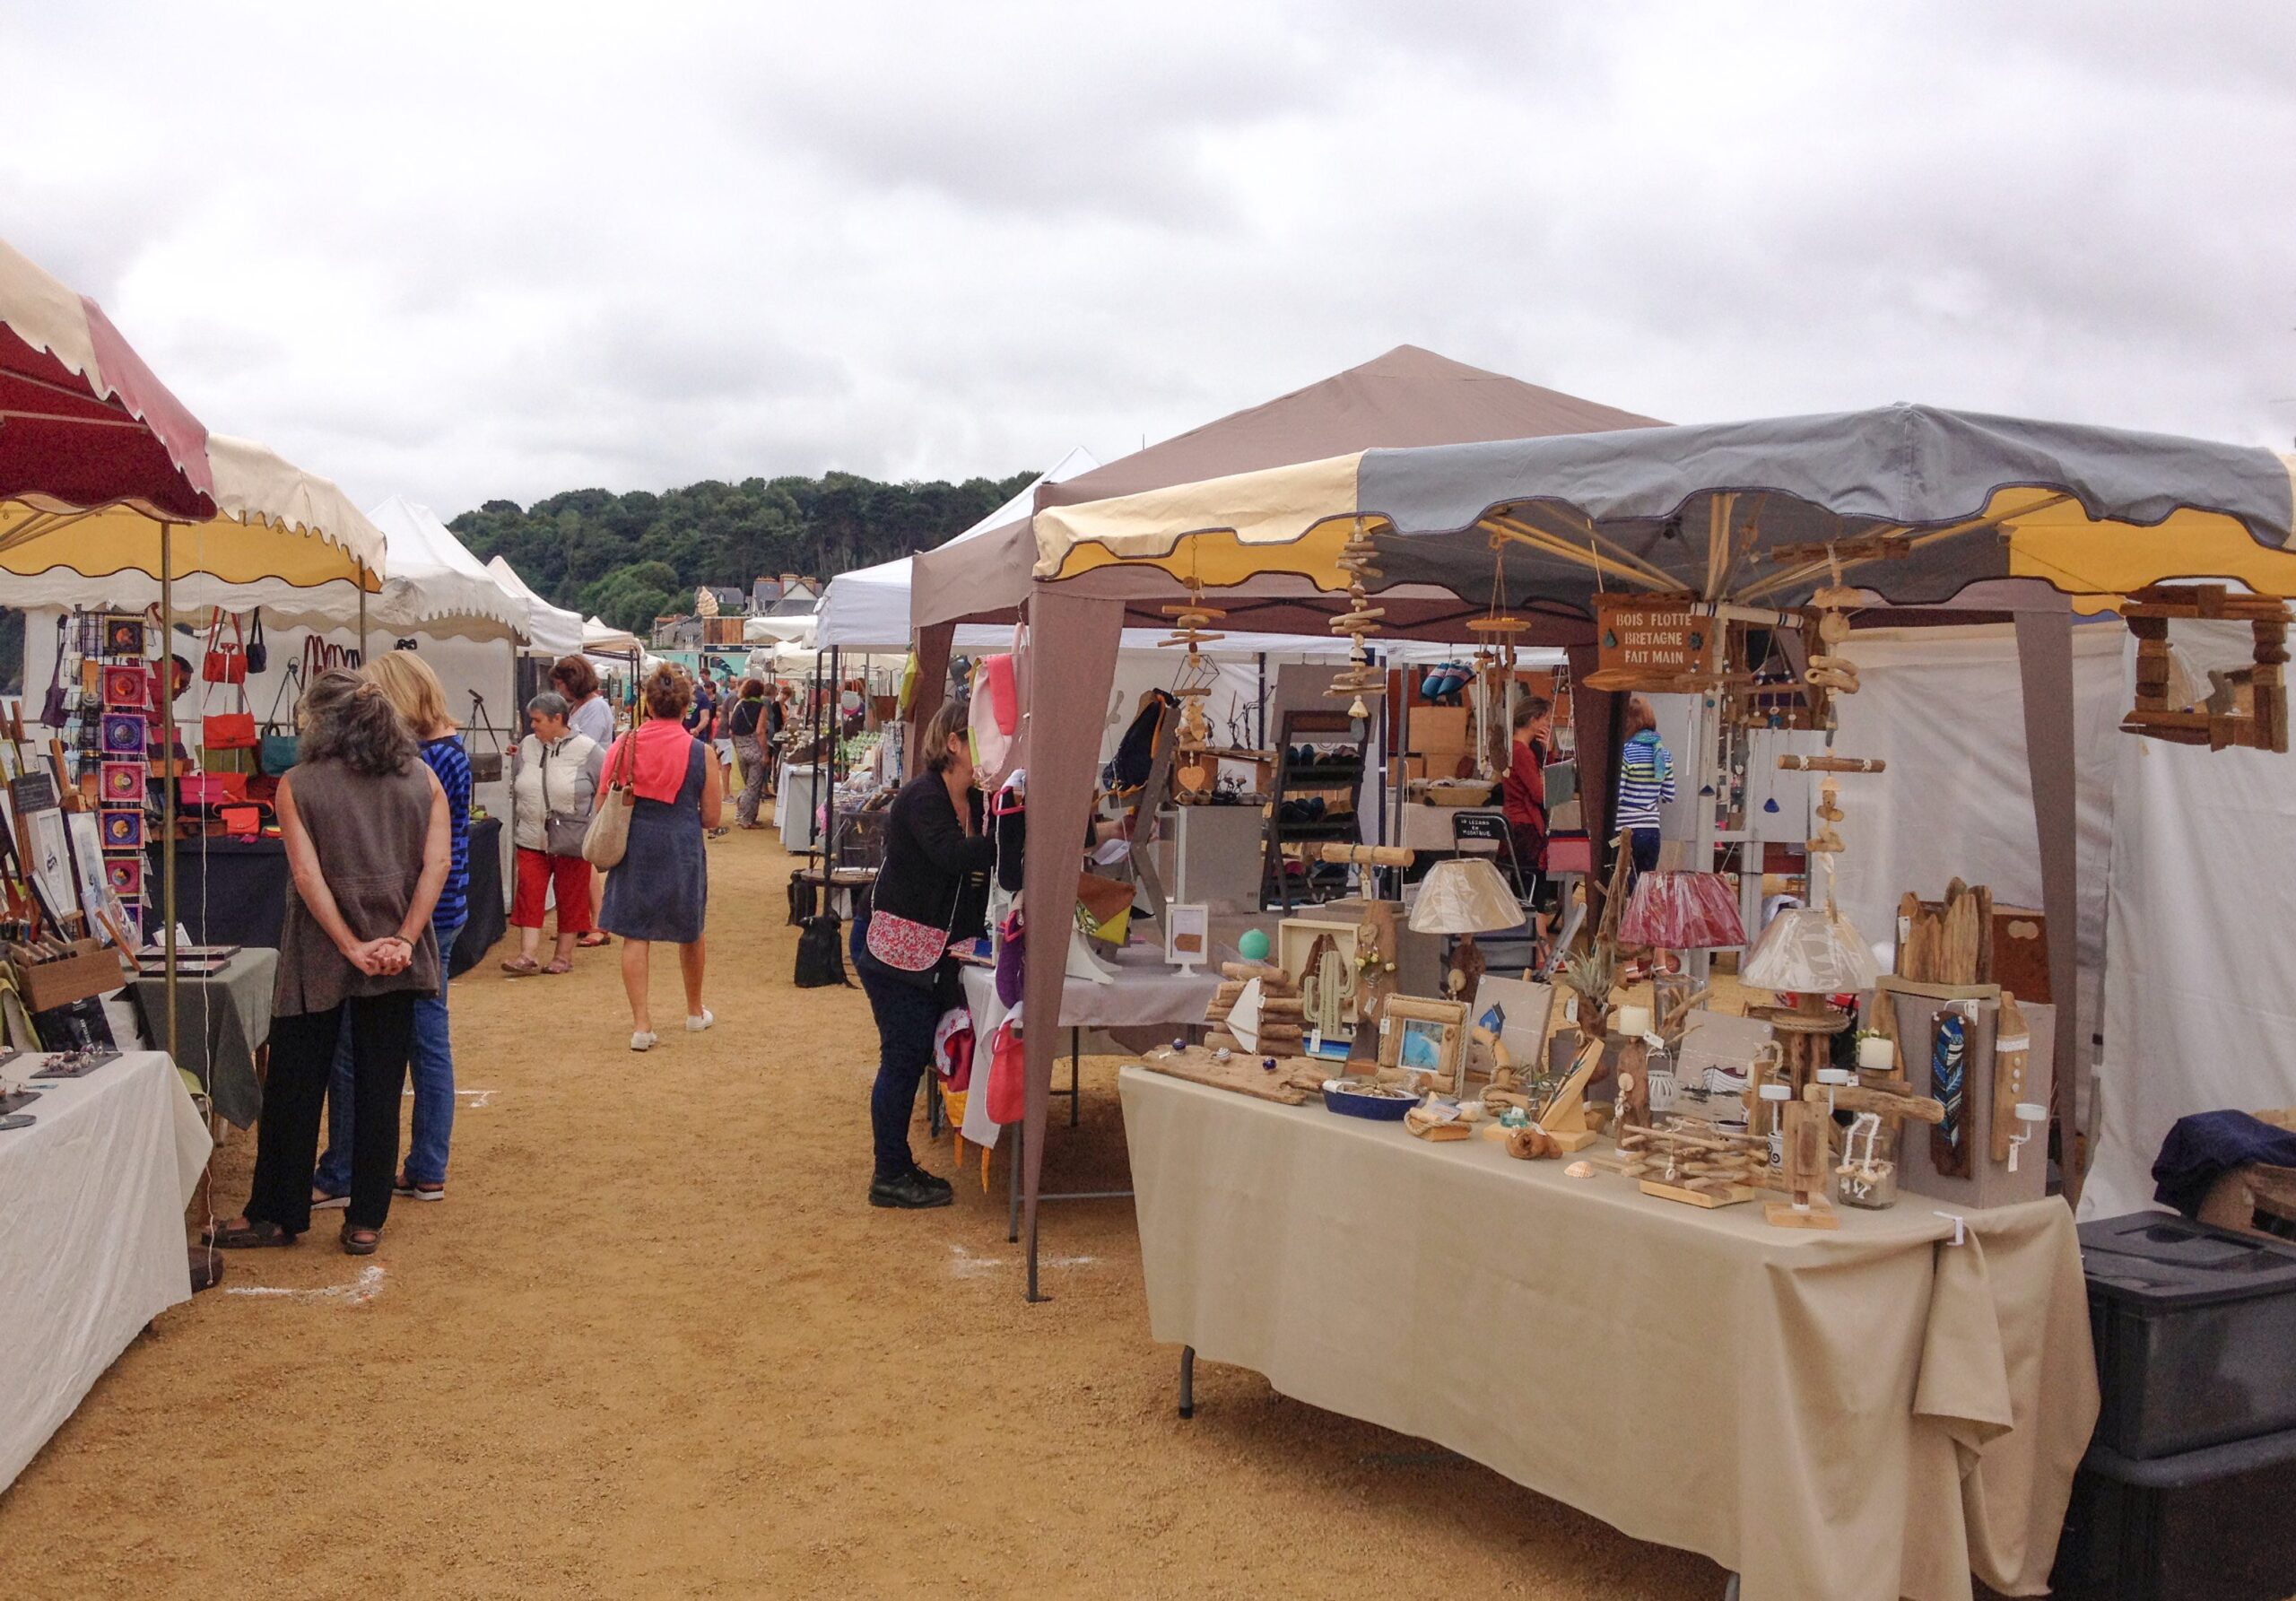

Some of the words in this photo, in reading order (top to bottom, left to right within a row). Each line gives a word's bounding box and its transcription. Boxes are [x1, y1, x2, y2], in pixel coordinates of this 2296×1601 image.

[1616, 613, 1643, 627] BOIS
[1650, 613, 1692, 627] FLOTTE
[1624, 631, 1683, 646] BRETAGNE
[1624, 650, 1648, 664] FAIT
[1652, 650, 1684, 665] MAIN
